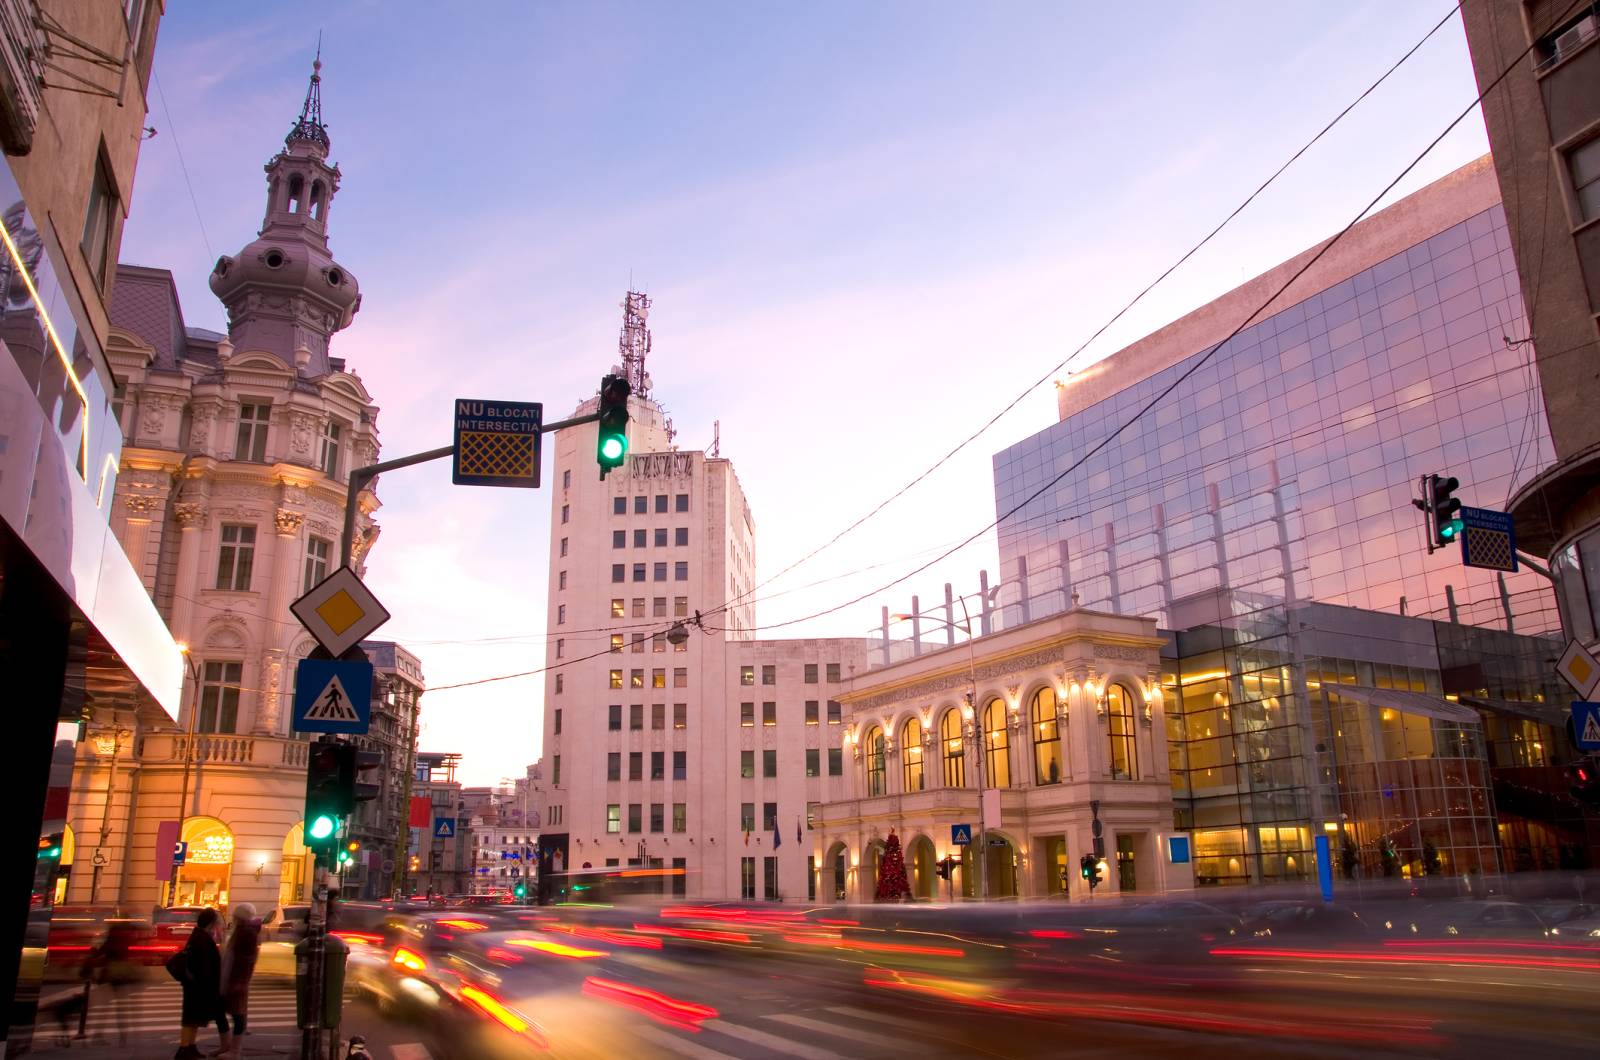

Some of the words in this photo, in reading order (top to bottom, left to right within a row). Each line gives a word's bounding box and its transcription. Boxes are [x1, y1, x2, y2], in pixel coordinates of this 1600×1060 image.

[458, 402, 484, 416] NU
[487, 407, 539, 419] BLOCATI
[457, 419, 539, 432] INTERSECTIA
[1466, 508, 1480, 519] NU
